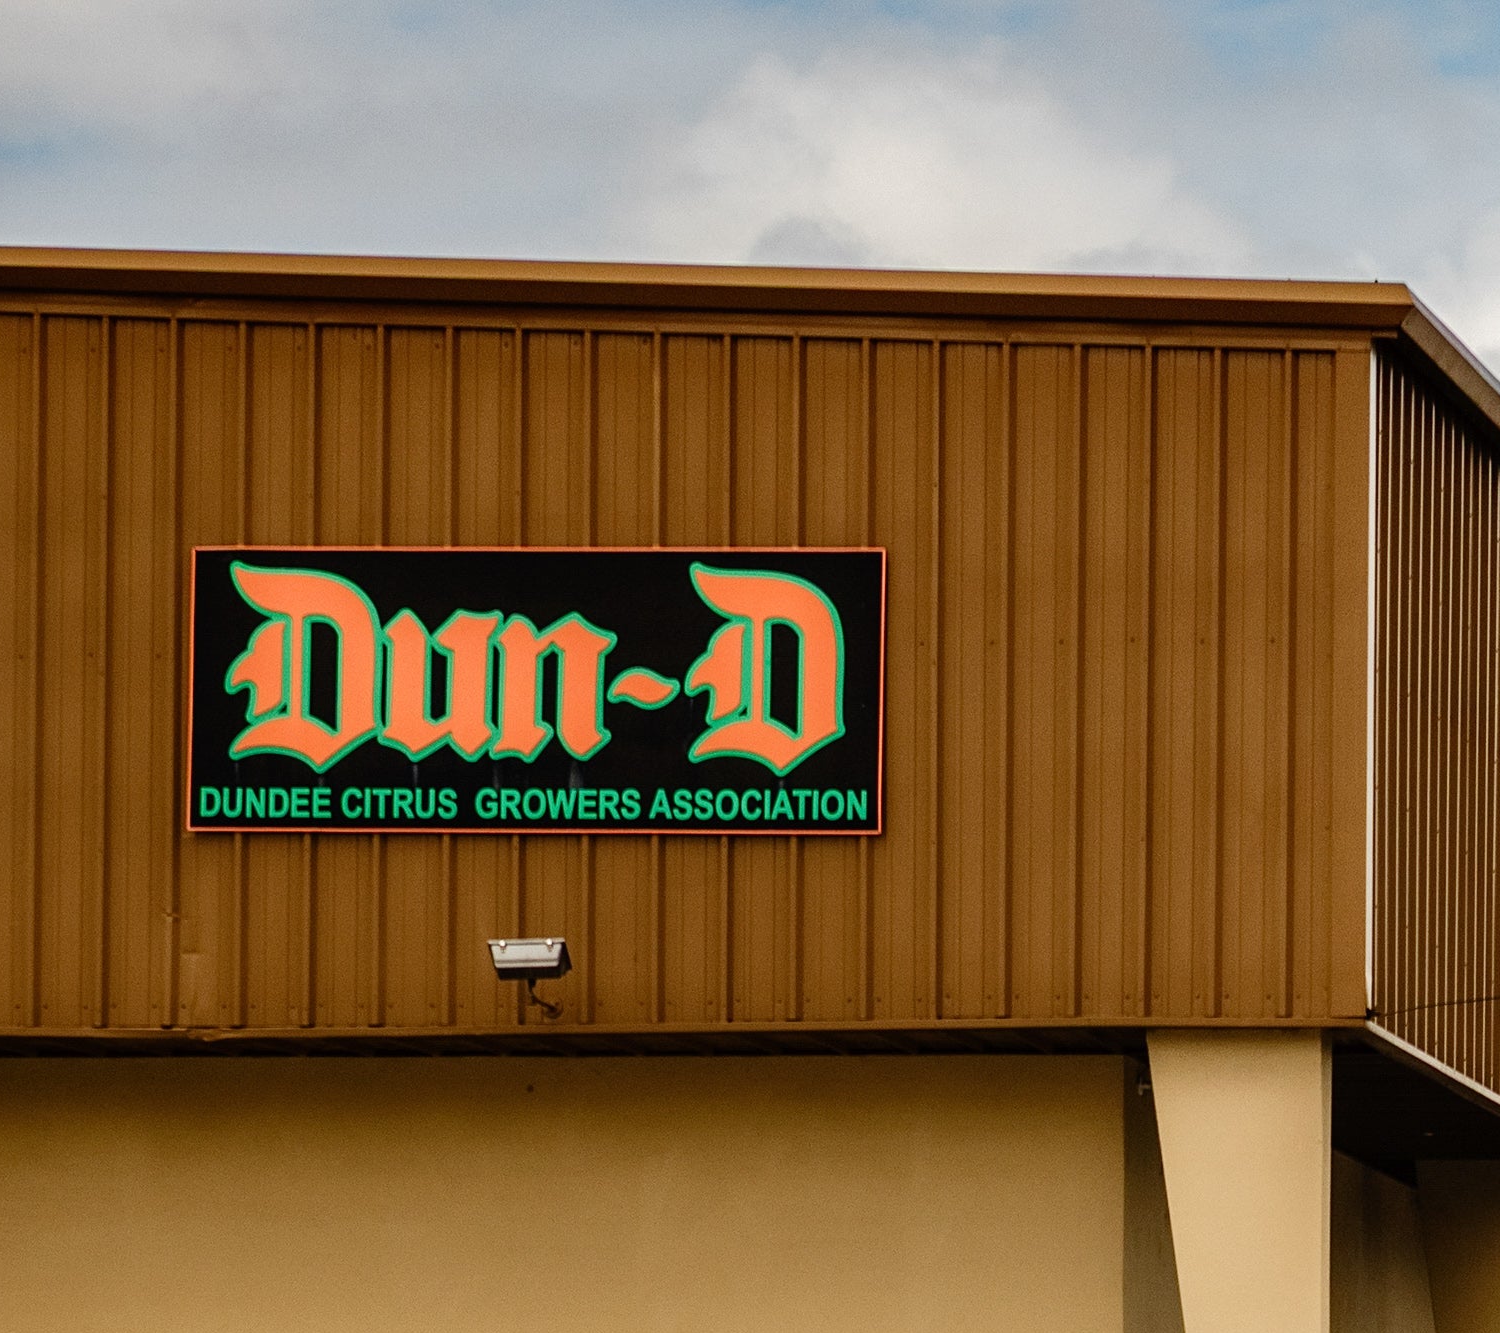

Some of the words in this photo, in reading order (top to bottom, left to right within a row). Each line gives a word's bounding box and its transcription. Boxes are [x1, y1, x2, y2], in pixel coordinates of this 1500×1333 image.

[225, 561, 846, 778] Dun-D
[199, 787, 332, 819] DUNDEE
[341, 787, 458, 819] CITRUS
[475, 788, 641, 820] GROWERS
[649, 788, 868, 822] ASSOCIATION
